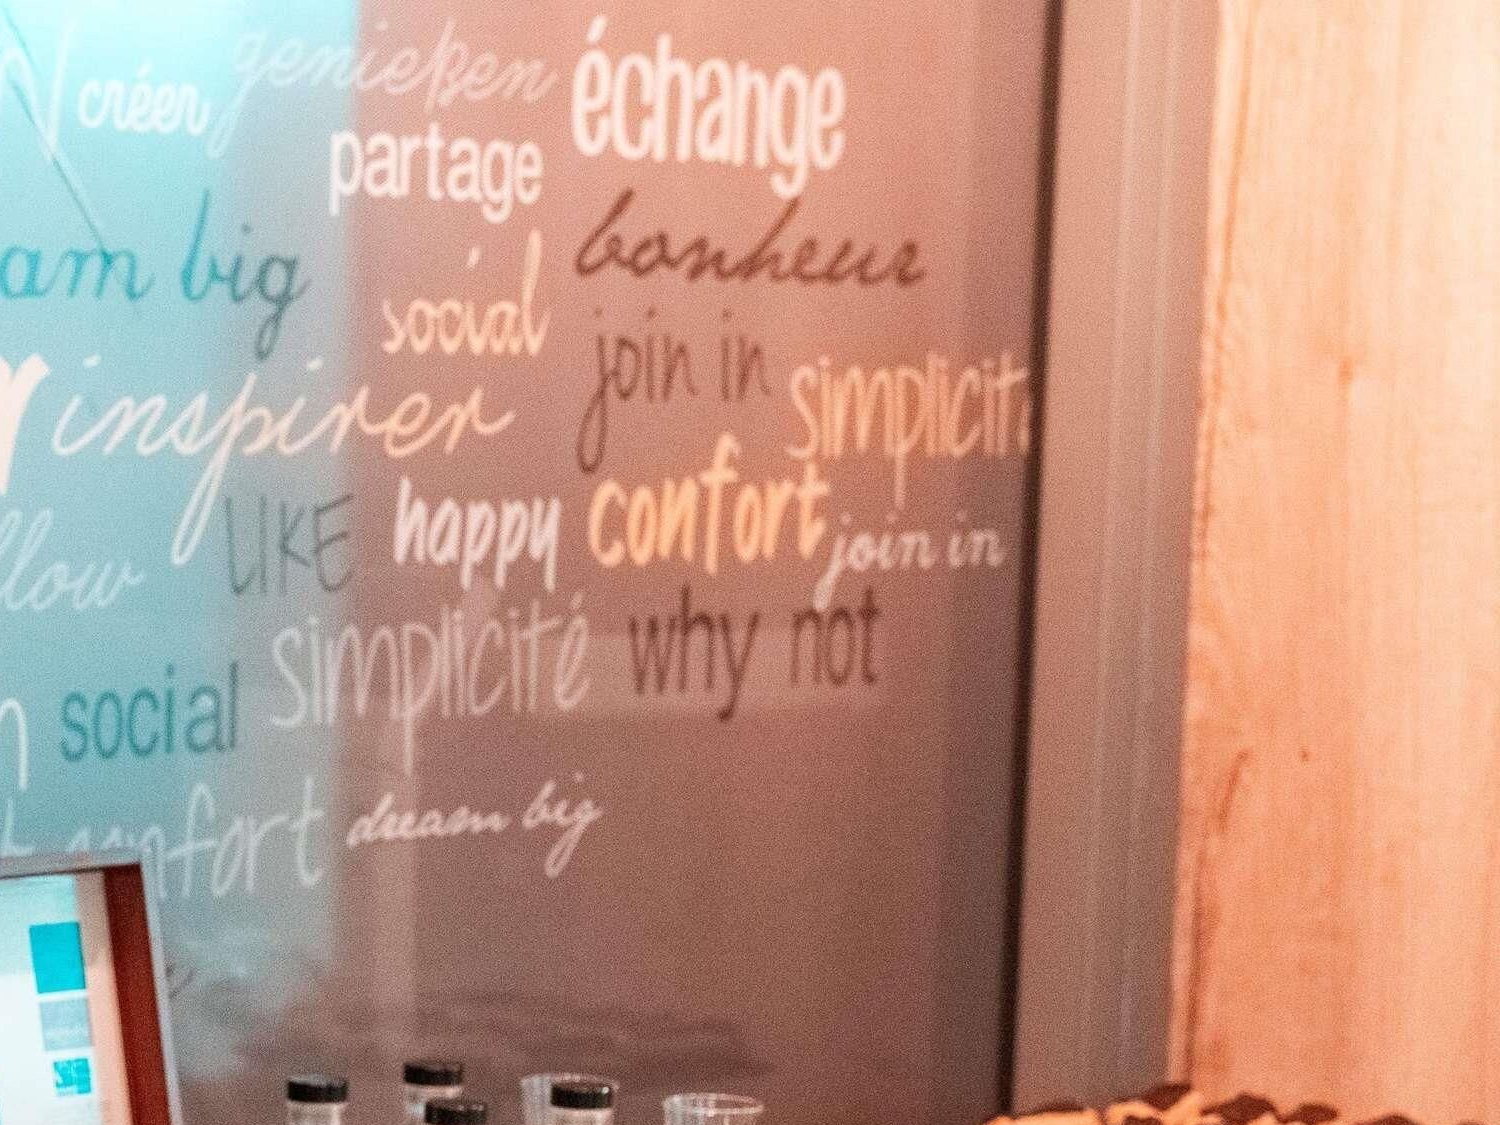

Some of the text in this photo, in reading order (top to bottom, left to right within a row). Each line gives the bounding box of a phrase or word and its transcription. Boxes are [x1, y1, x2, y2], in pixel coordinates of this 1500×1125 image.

[77, 60, 208, 136] créer
[571, 14, 846, 200] échange
[327, 124, 545, 224] partage
[180, 186, 312, 362] big
[381, 230, 552, 358] social
[575, 188, 928, 290] bonheur
[578, 308, 774, 474] join in
[50, 352, 516, 566] inspirer
[588, 432, 832, 574] confort
[222, 494, 356, 598] LIKE
[391, 476, 560, 588] happy
[812, 510, 1006, 612] join in
[61, 664, 238, 760] social
[268, 594, 594, 774] simplicité
[628, 584, 882, 722] why not
[68, 772, 327, 899] nfort
[346, 774, 602, 878] dream big
